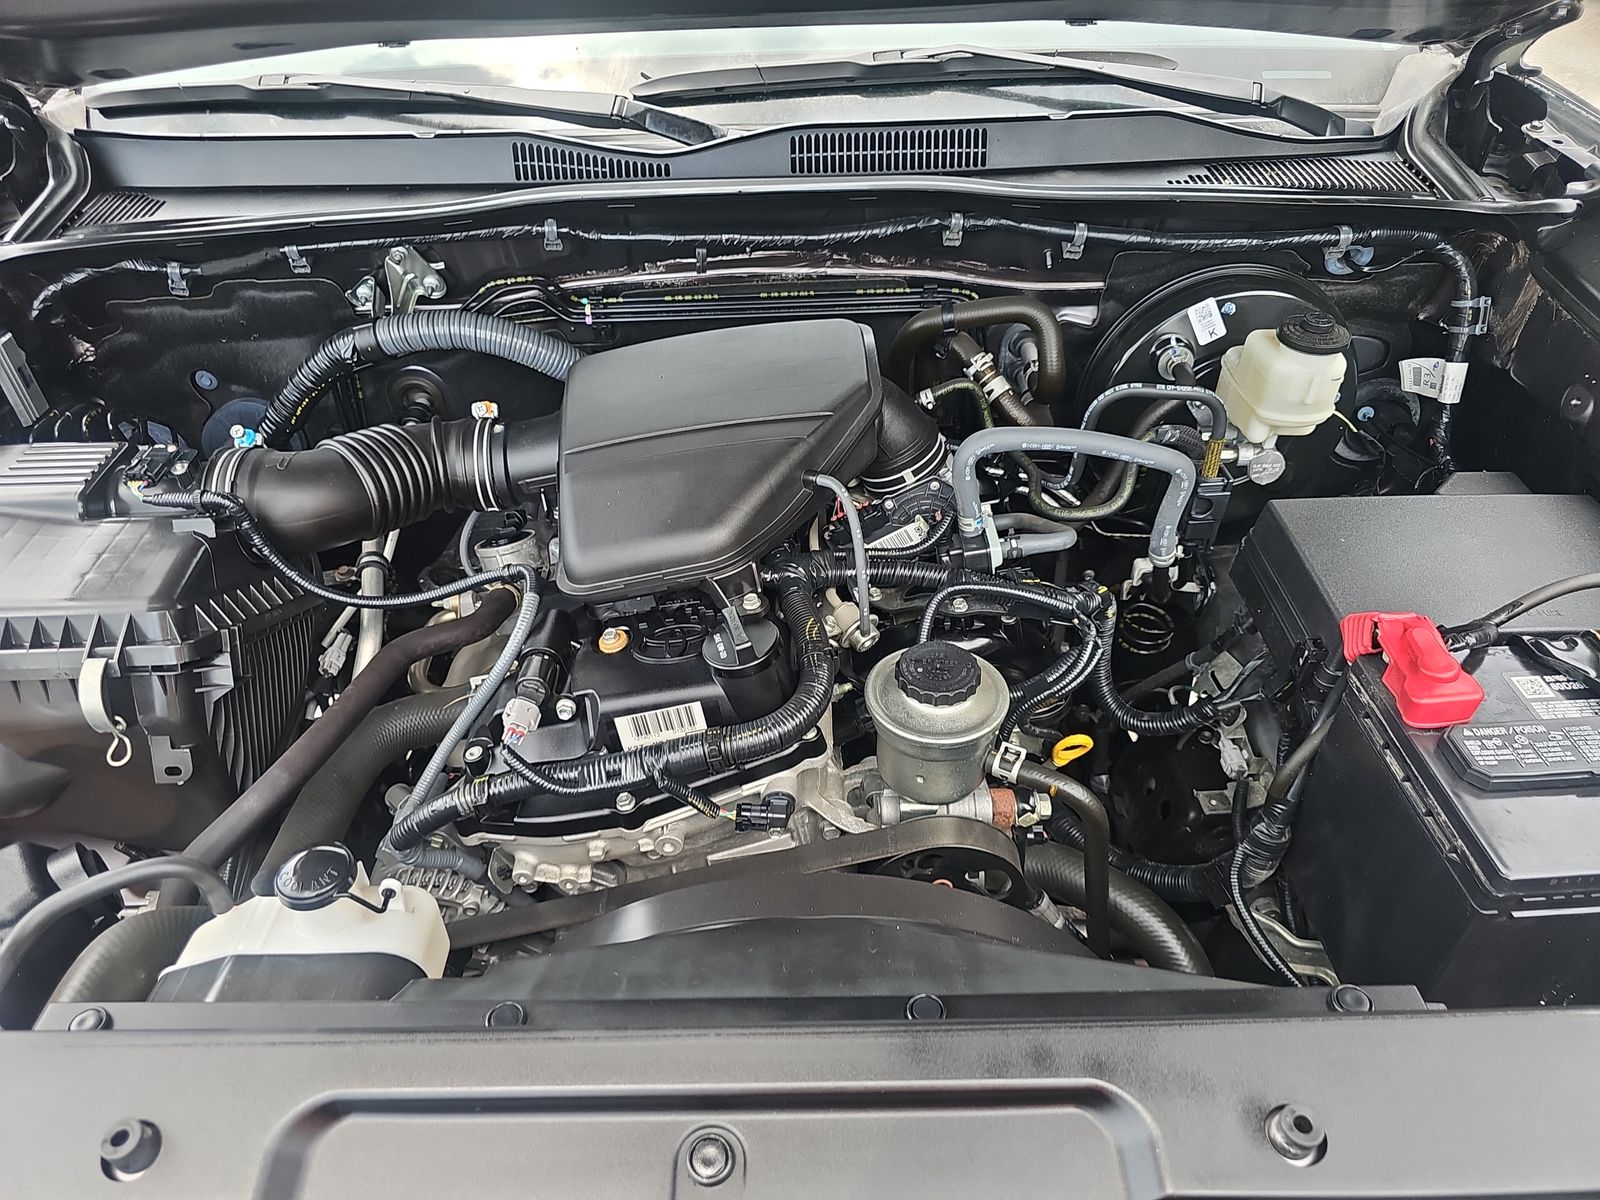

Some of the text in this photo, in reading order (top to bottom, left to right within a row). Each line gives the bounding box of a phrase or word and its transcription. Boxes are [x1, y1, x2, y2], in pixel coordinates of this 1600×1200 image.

[1207, 327, 1219, 339] K
[1472, 727, 1508, 737] DANGER
[1513, 724, 1547, 735] POISON
[278, 865, 339, 893] COOLANT
